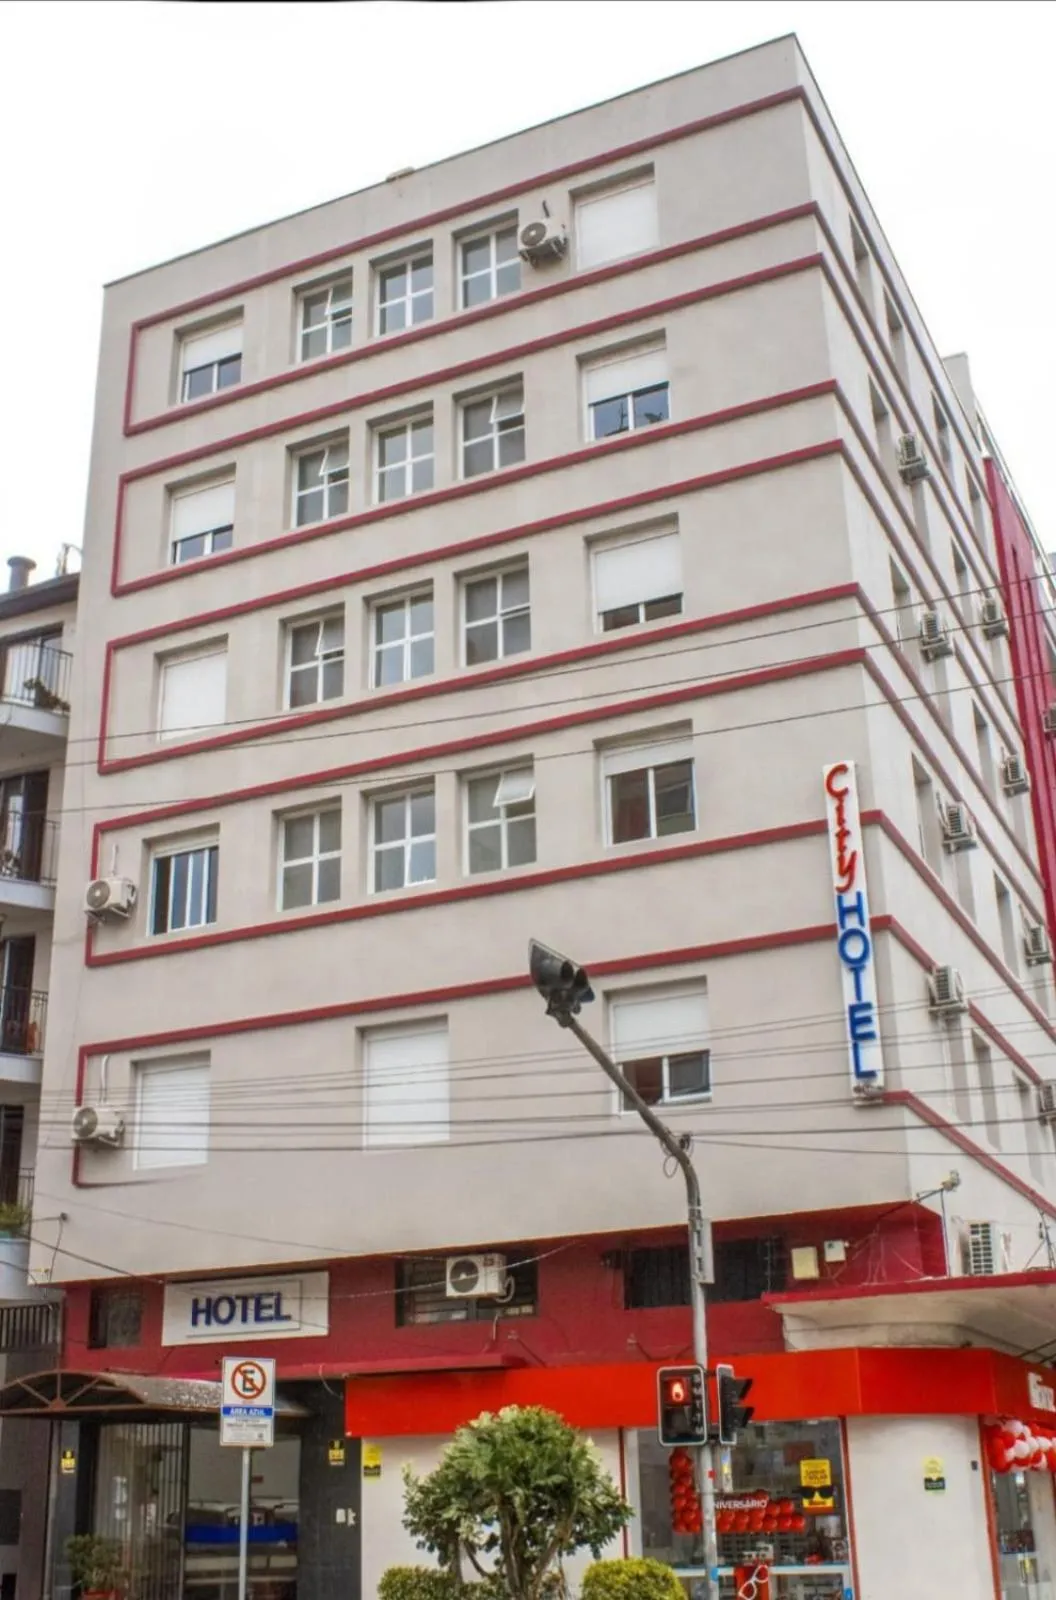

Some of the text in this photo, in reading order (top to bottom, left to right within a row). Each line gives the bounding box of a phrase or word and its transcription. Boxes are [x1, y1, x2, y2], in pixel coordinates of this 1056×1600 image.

[825, 763, 877, 1079] City HOTEL
[191, 1291, 292, 1327] HOTEL
